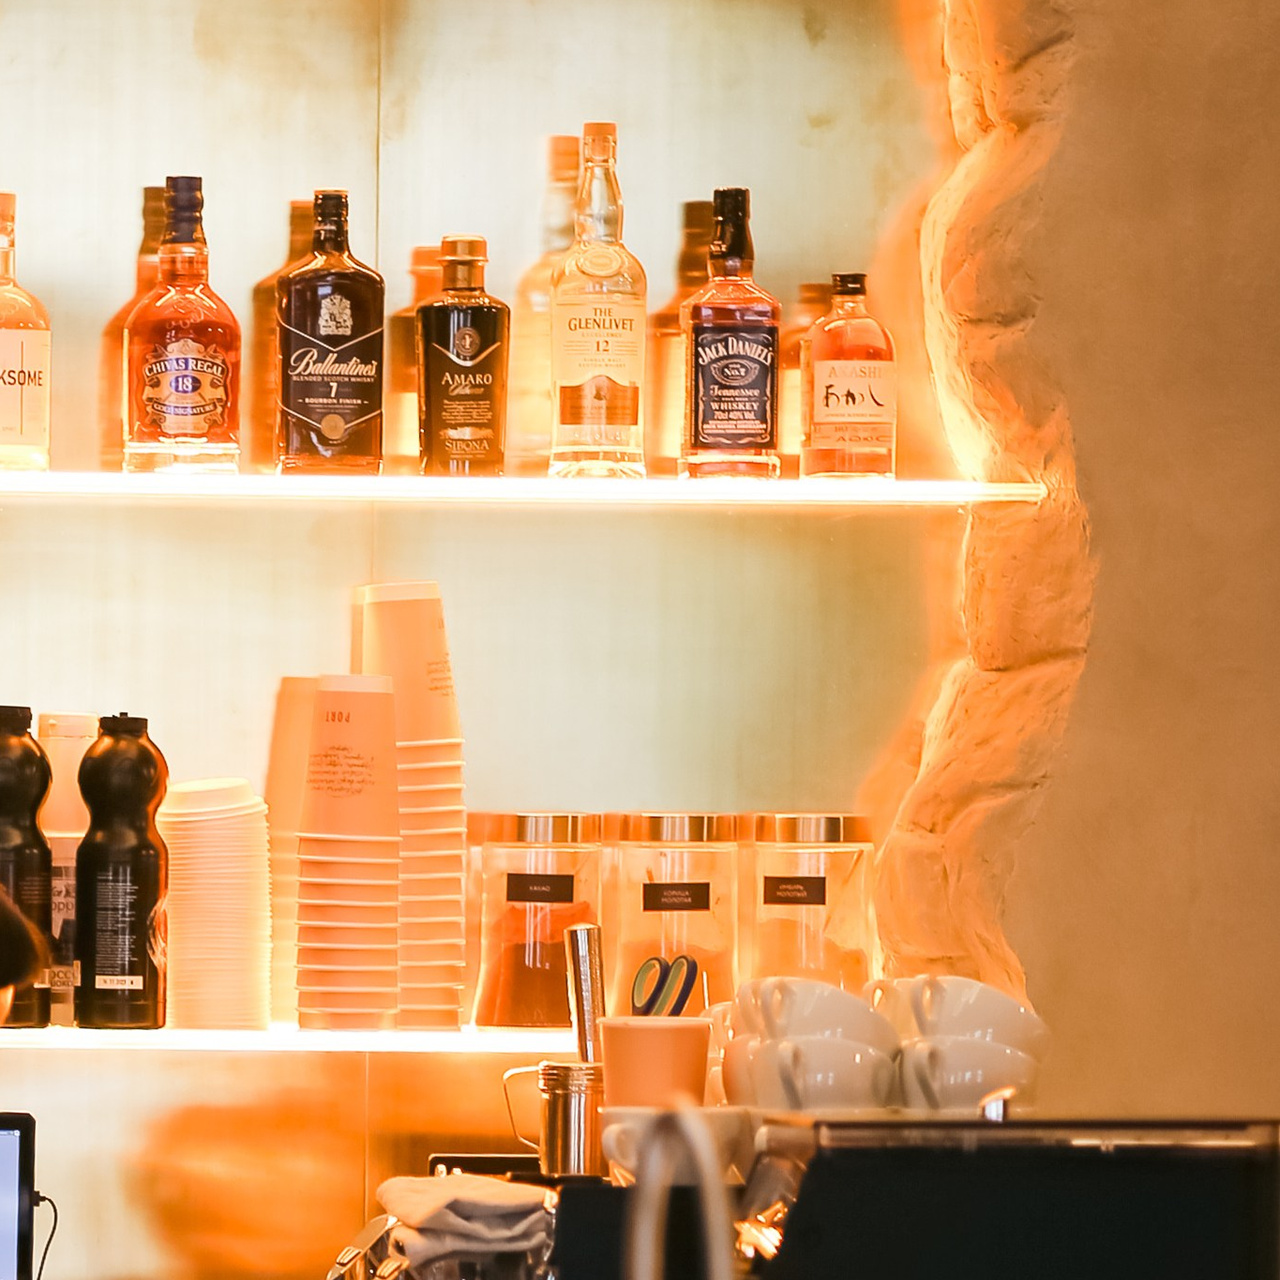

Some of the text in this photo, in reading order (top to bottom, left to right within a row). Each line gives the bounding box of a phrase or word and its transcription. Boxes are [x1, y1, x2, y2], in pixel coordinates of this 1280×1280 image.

[593, 307, 613, 317] THE
[568, 317, 634, 332] GLENLIVET
[596, 340, 610, 352] 12
[698, 337, 775, 366] JACK DANIEL'S
[145, 358, 224, 377] CHIVAS REGAL
[288, 347, 378, 376] Ballantine's
[441, 372, 493, 385] AMARO
[829, 366, 882, 378] AASHI
[177, 377, 192, 391] 18
[329, 382, 337, 397] 7
[710, 384, 760, 396] Tennessee
[710, 401, 760, 411] WHISKEY
[445, 440, 489, 451] SIBONA
